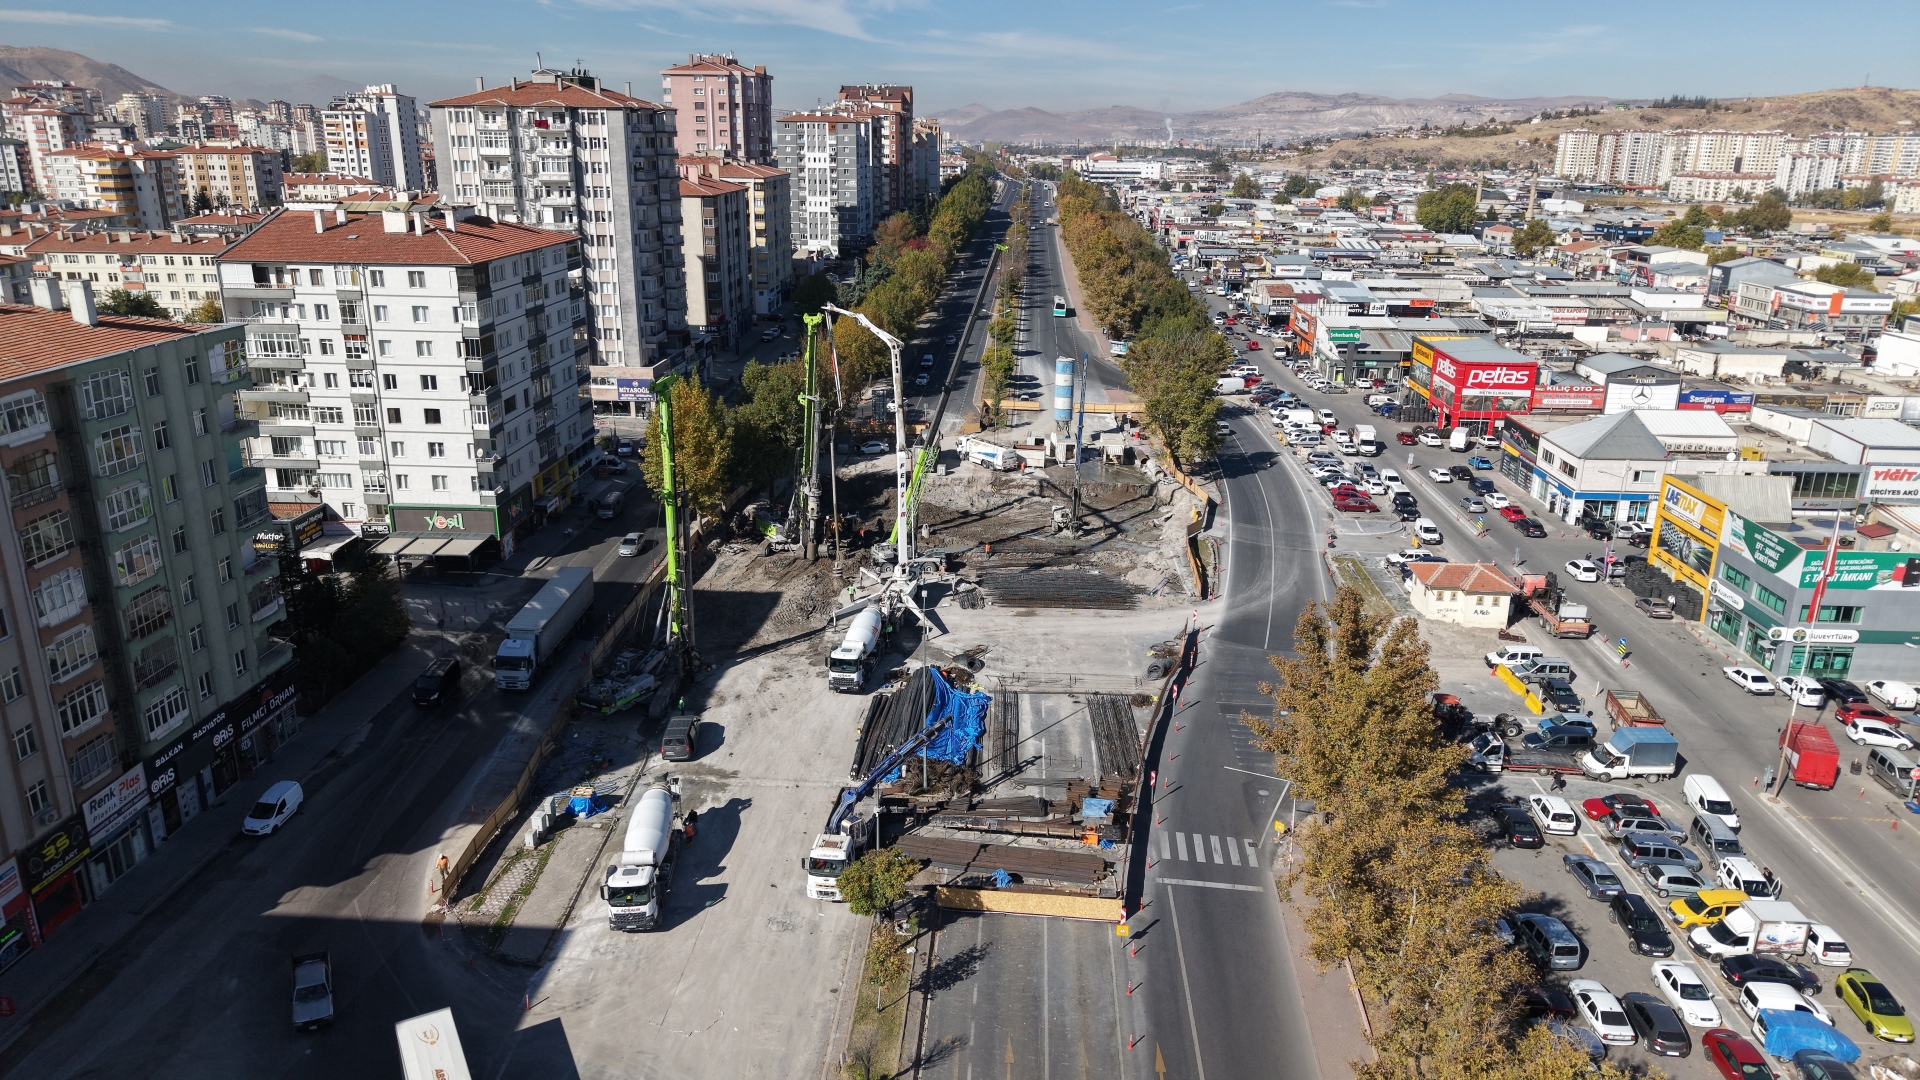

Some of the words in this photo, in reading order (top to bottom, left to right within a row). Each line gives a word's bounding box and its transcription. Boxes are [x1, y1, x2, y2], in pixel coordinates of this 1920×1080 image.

[1436, 356, 1456, 379] petlas
[1466, 366, 1530, 386] petlas
[1804, 574, 1811, 582] 5
[1812, 571, 1840, 582] TASİT
[1839, 571, 1872, 581] İMKANI
[270, 684, 295, 710] ORHAN
[155, 742, 183, 768] BALKAN
[192, 712, 226, 741] RADYATÖR
[90, 787, 116, 814] Renk
[118, 774, 140, 796] Plas
[93, 802, 118, 824] Plastik
[119, 785, 141, 805] Sanayi
[42, 860, 63, 879] AUDIO
[64, 848, 78, 864] ART
